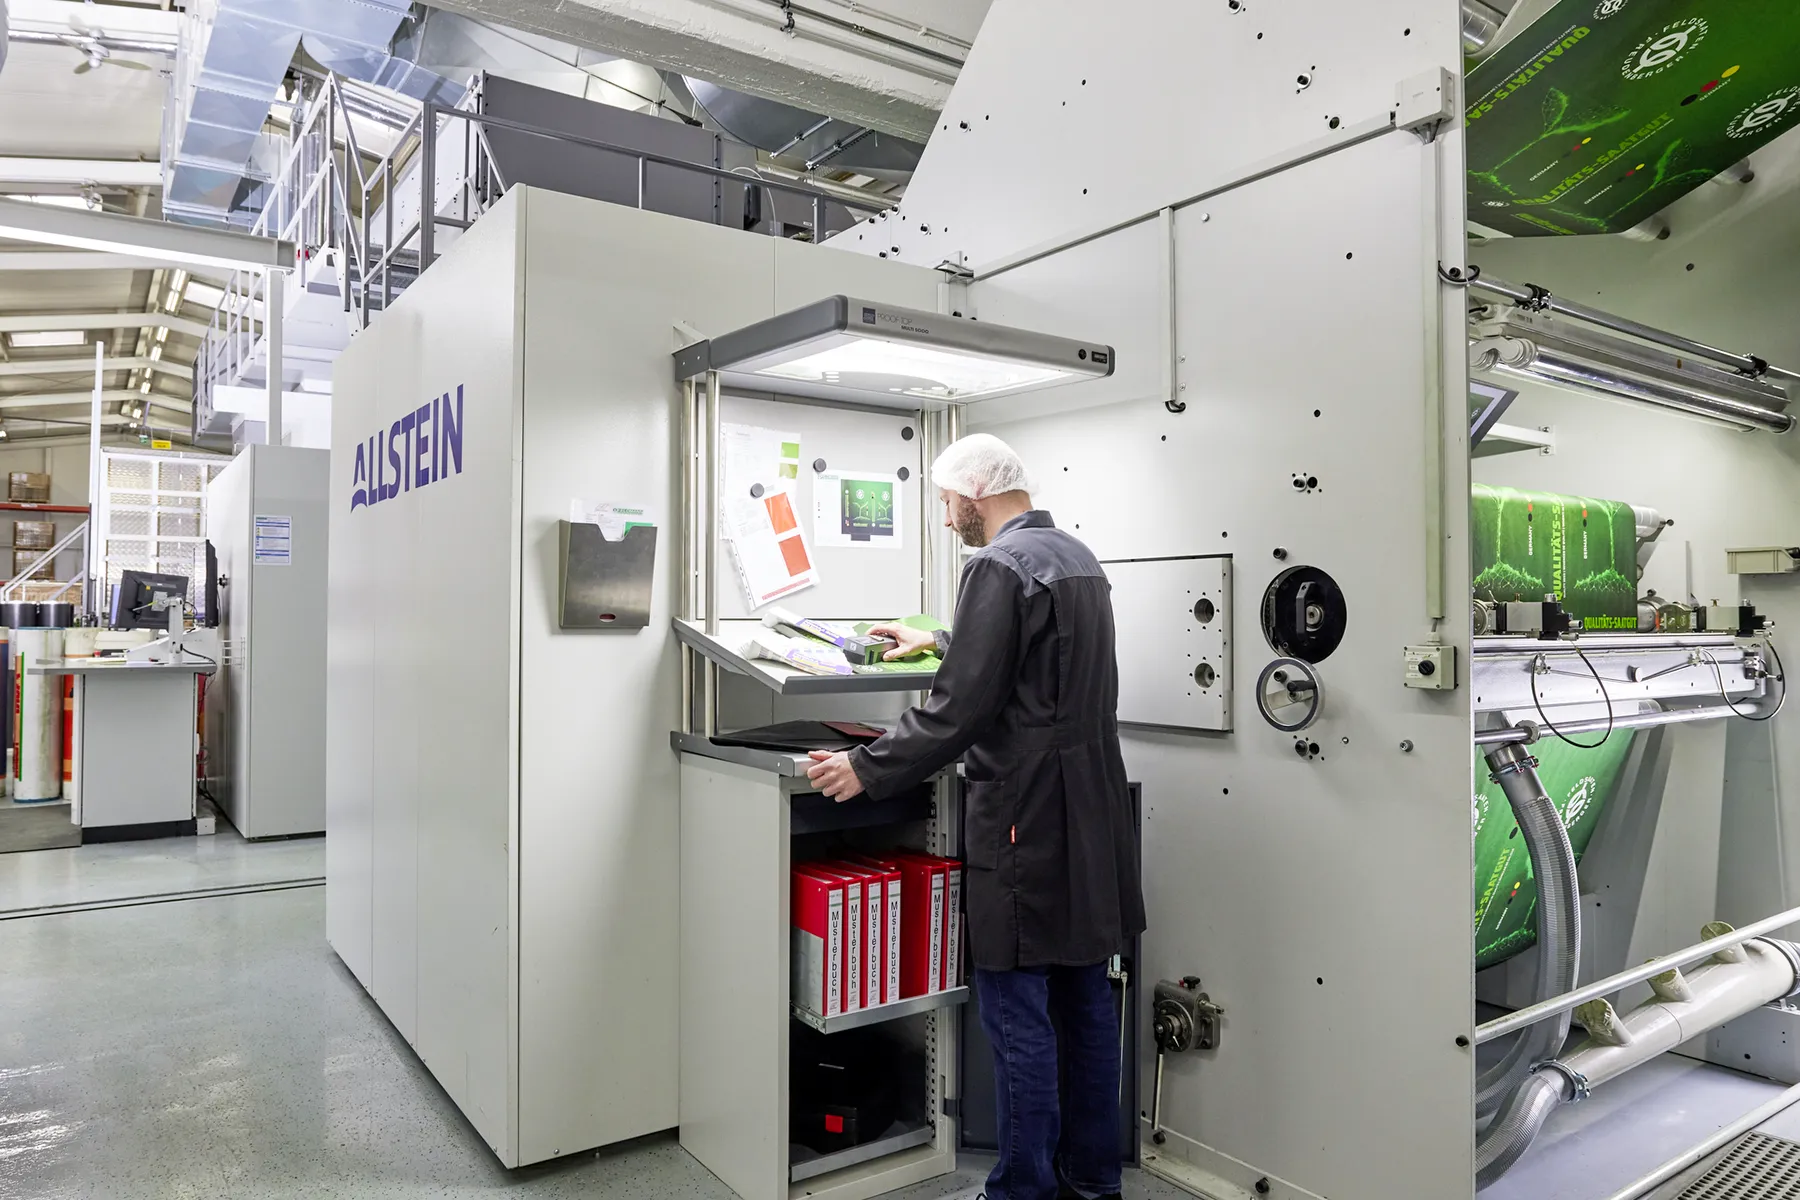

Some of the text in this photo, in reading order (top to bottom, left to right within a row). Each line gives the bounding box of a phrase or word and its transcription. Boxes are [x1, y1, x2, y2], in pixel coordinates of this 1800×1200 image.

[1529, 160, 1559, 182] GERMANY
[1583, 184, 1613, 205] GERMANY
[877, 312, 900, 324] PROOF
[901, 316, 913, 326] TOP
[350, 383, 464, 513] ALLSTEIN
[831, 911, 839, 997] Musterbuch
[850, 904, 858, 989] Musterbuch
[870, 903, 878, 988] Musterbuch
[932, 894, 941, 975] Musterbuch
[949, 889, 958, 971] Musterbuch
